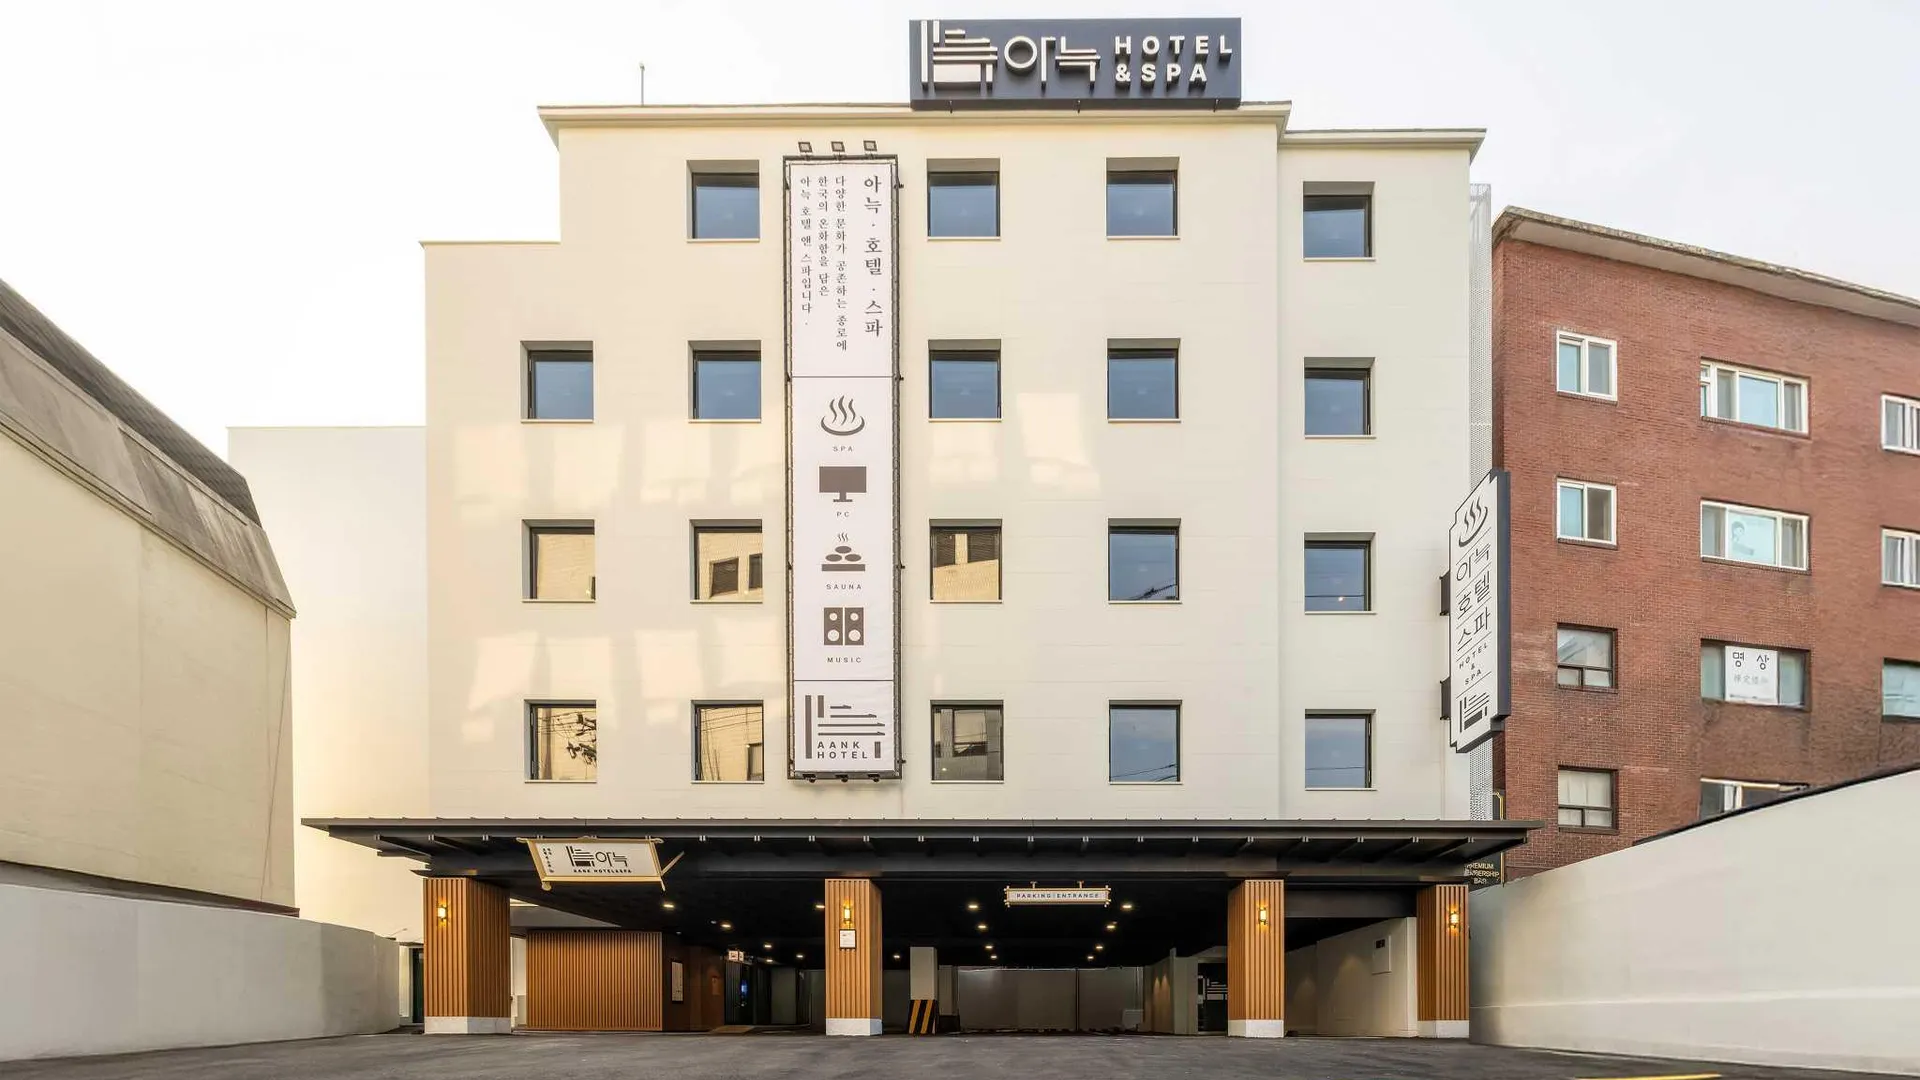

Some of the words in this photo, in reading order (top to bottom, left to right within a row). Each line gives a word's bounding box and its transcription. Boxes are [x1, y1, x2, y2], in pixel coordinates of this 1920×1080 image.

[1114, 34, 1233, 59] HOTEL
[1114, 62, 1208, 85] &SPA
[800, 176, 812, 200] 아늑
[818, 175, 829, 212] 한국의
[835, 175, 847, 212] 다양한
[864, 175, 882, 214] 아늑
[801, 205, 812, 230] 호텔
[801, 235, 812, 247] 앤
[836, 218, 848, 255] 문화가
[863, 237, 883, 276] 호텔
[818, 273, 830, 297] 담은
[836, 260, 848, 309] 공존하는
[864, 300, 884, 338] 스파
[836, 315, 848, 352] 종로에
[832, 445, 854, 453] SPA
[836, 511, 850, 519] PC
[1456, 543, 1491, 582] 아늑
[826, 583, 862, 591] SAUNA
[1457, 570, 1491, 620] 호텔
[1457, 606, 1491, 652] 스파
[826, 656, 862, 664] MUSIC
[1459, 642, 1488, 670] HOTEL
[1464, 669, 1482, 686] SPA
[817, 740, 861, 750] AANK
[817, 750, 868, 760] HOTEL
